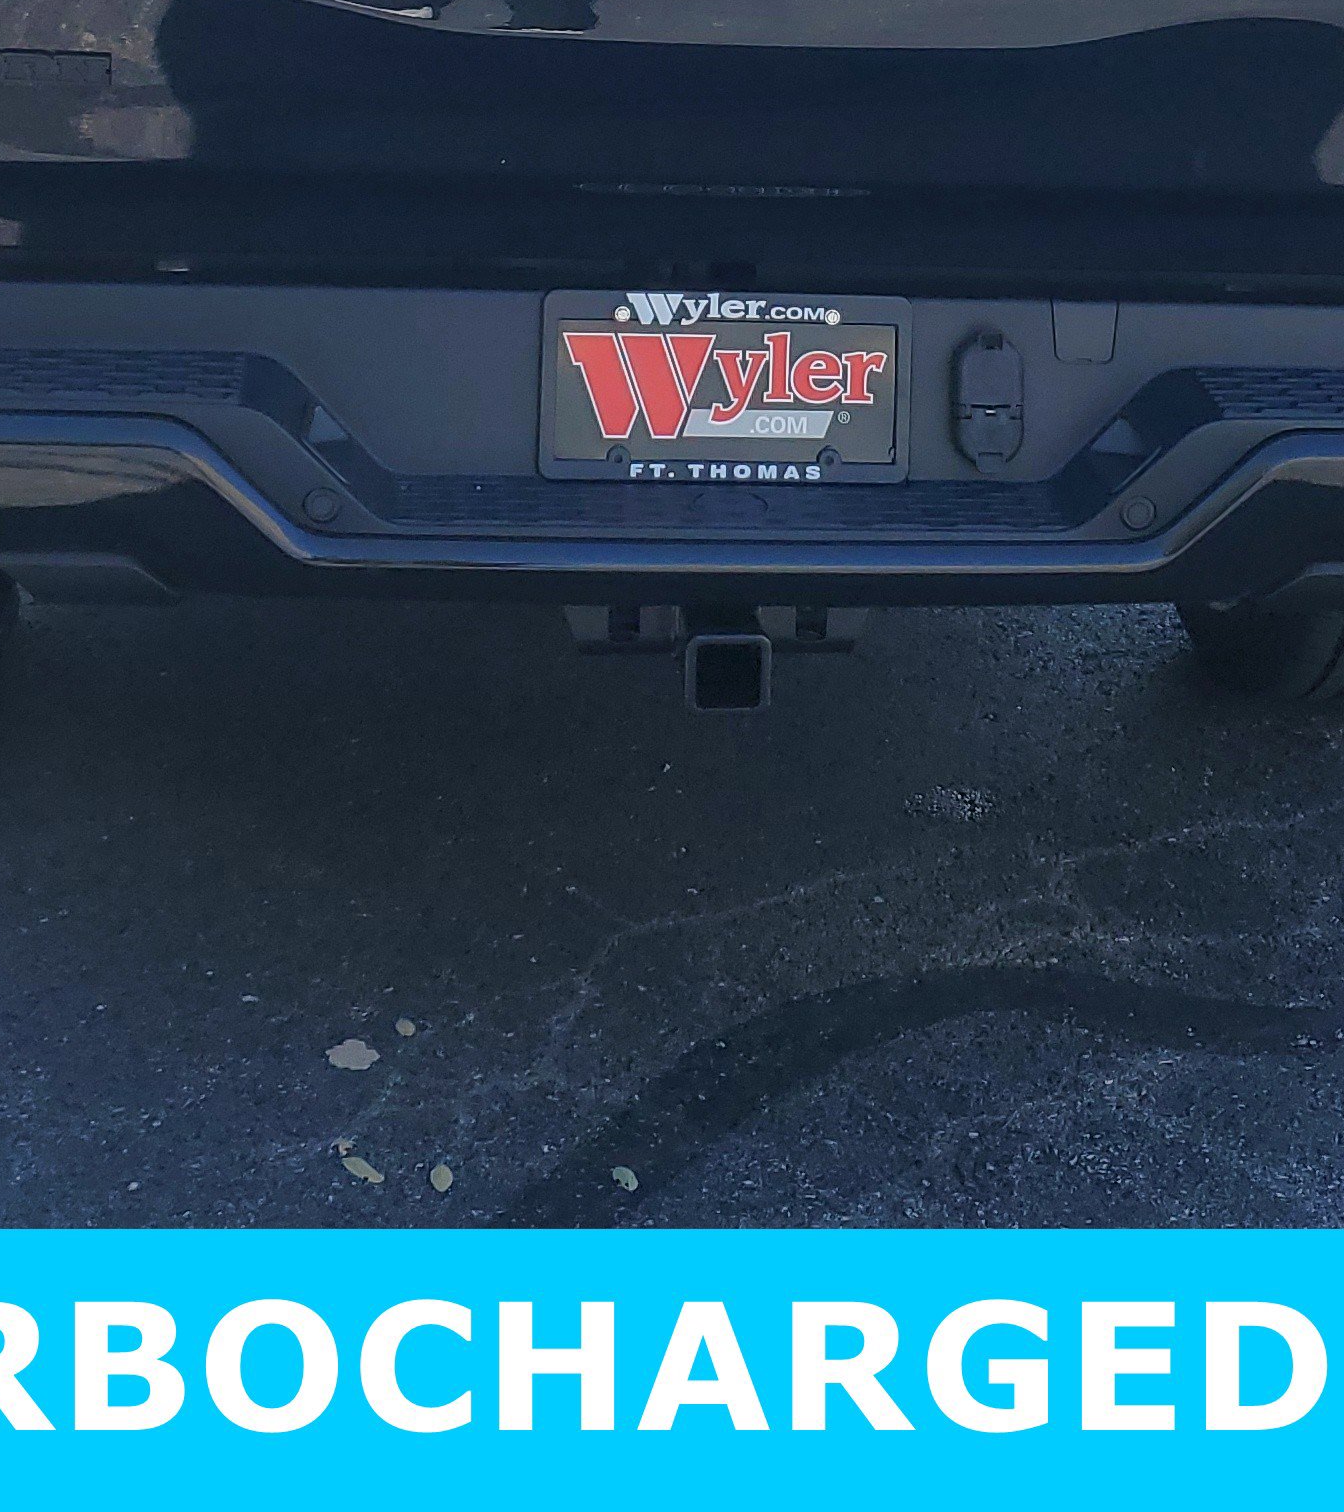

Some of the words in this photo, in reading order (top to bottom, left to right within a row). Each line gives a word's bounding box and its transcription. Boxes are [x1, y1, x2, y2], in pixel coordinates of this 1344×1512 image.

[562, 331, 888, 440] Wyler
[629, 463, 676, 479] FT.
[687, 464, 822, 480] THOMAS
